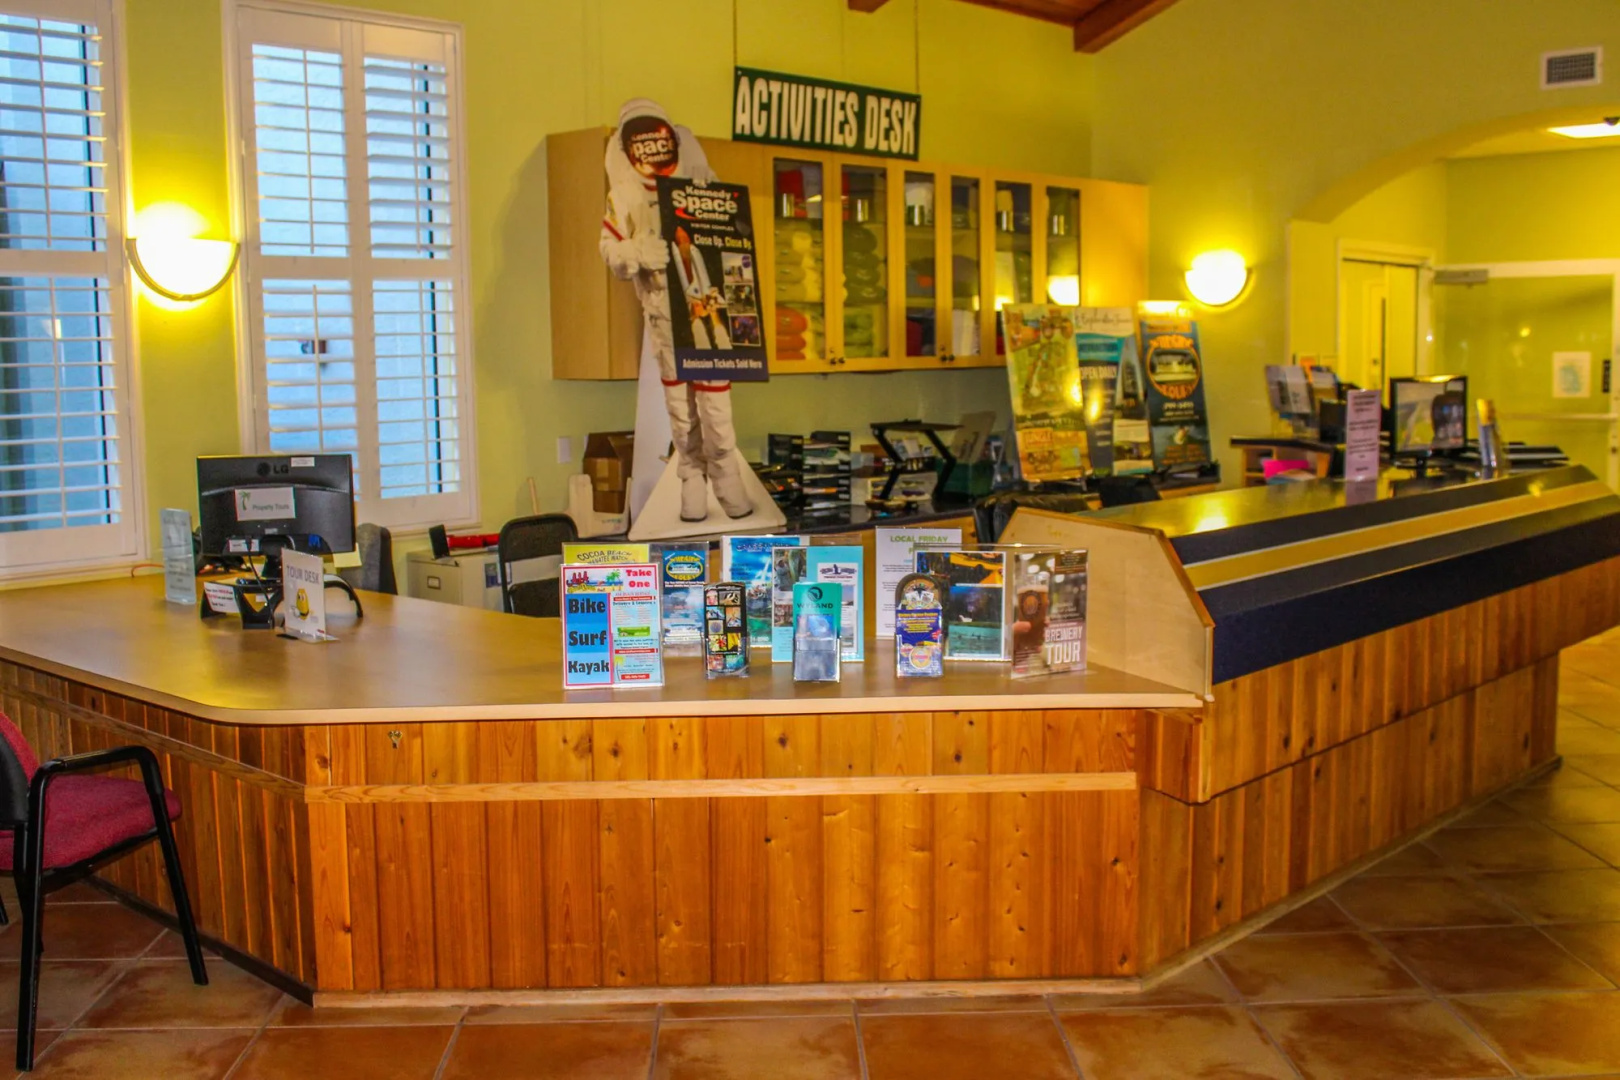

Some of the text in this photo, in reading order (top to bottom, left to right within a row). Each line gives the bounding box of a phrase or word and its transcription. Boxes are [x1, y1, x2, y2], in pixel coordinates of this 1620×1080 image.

[735, 76, 917, 155] ACTIVITIES DESK
[632, 138, 674, 158] pac
[685, 185, 731, 201] Kennedy
[671, 189, 738, 214] Space
[695, 209, 730, 221] Center
[714, 358, 735, 369] Tickets
[273, 464, 289, 474] LG
[252, 502, 290, 512] Property Tours
[890, 535, 949, 543] LOCAL FRIDAY
[577, 550, 606, 561] COCOA
[286, 565, 320, 584] TOUR DESK
[625, 569, 652, 578] Take
[628, 580, 651, 588] One
[568, 598, 606, 614] Bike
[568, 629, 607, 646] Surf
[1044, 625, 1083, 643] BREWERY
[1045, 640, 1082, 665] TOUR
[567, 659, 610, 676] Kayak
